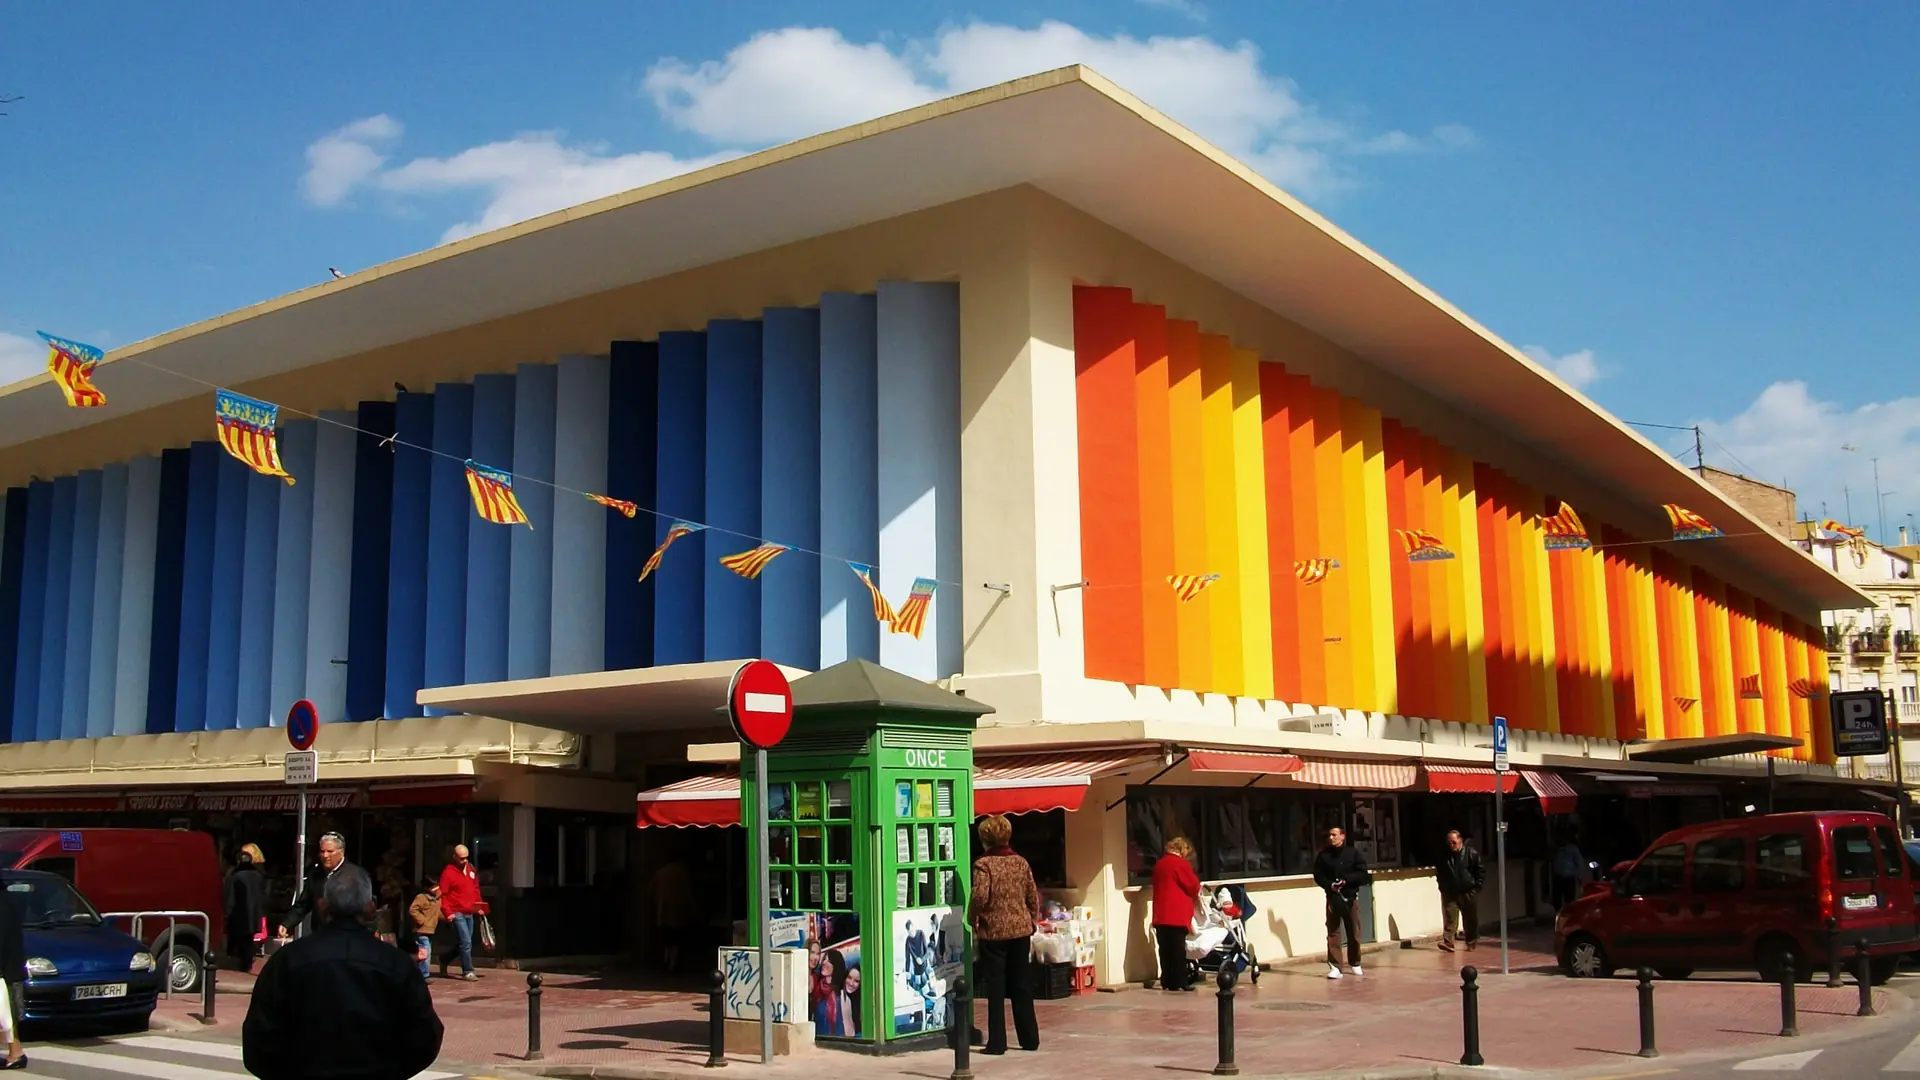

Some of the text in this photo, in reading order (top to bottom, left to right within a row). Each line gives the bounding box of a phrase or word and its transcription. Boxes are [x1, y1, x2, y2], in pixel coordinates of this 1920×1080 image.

[1843, 699, 1871, 729] P
[905, 749, 948, 768] ONCE
[77, 985, 122, 998] 7843 CRH
